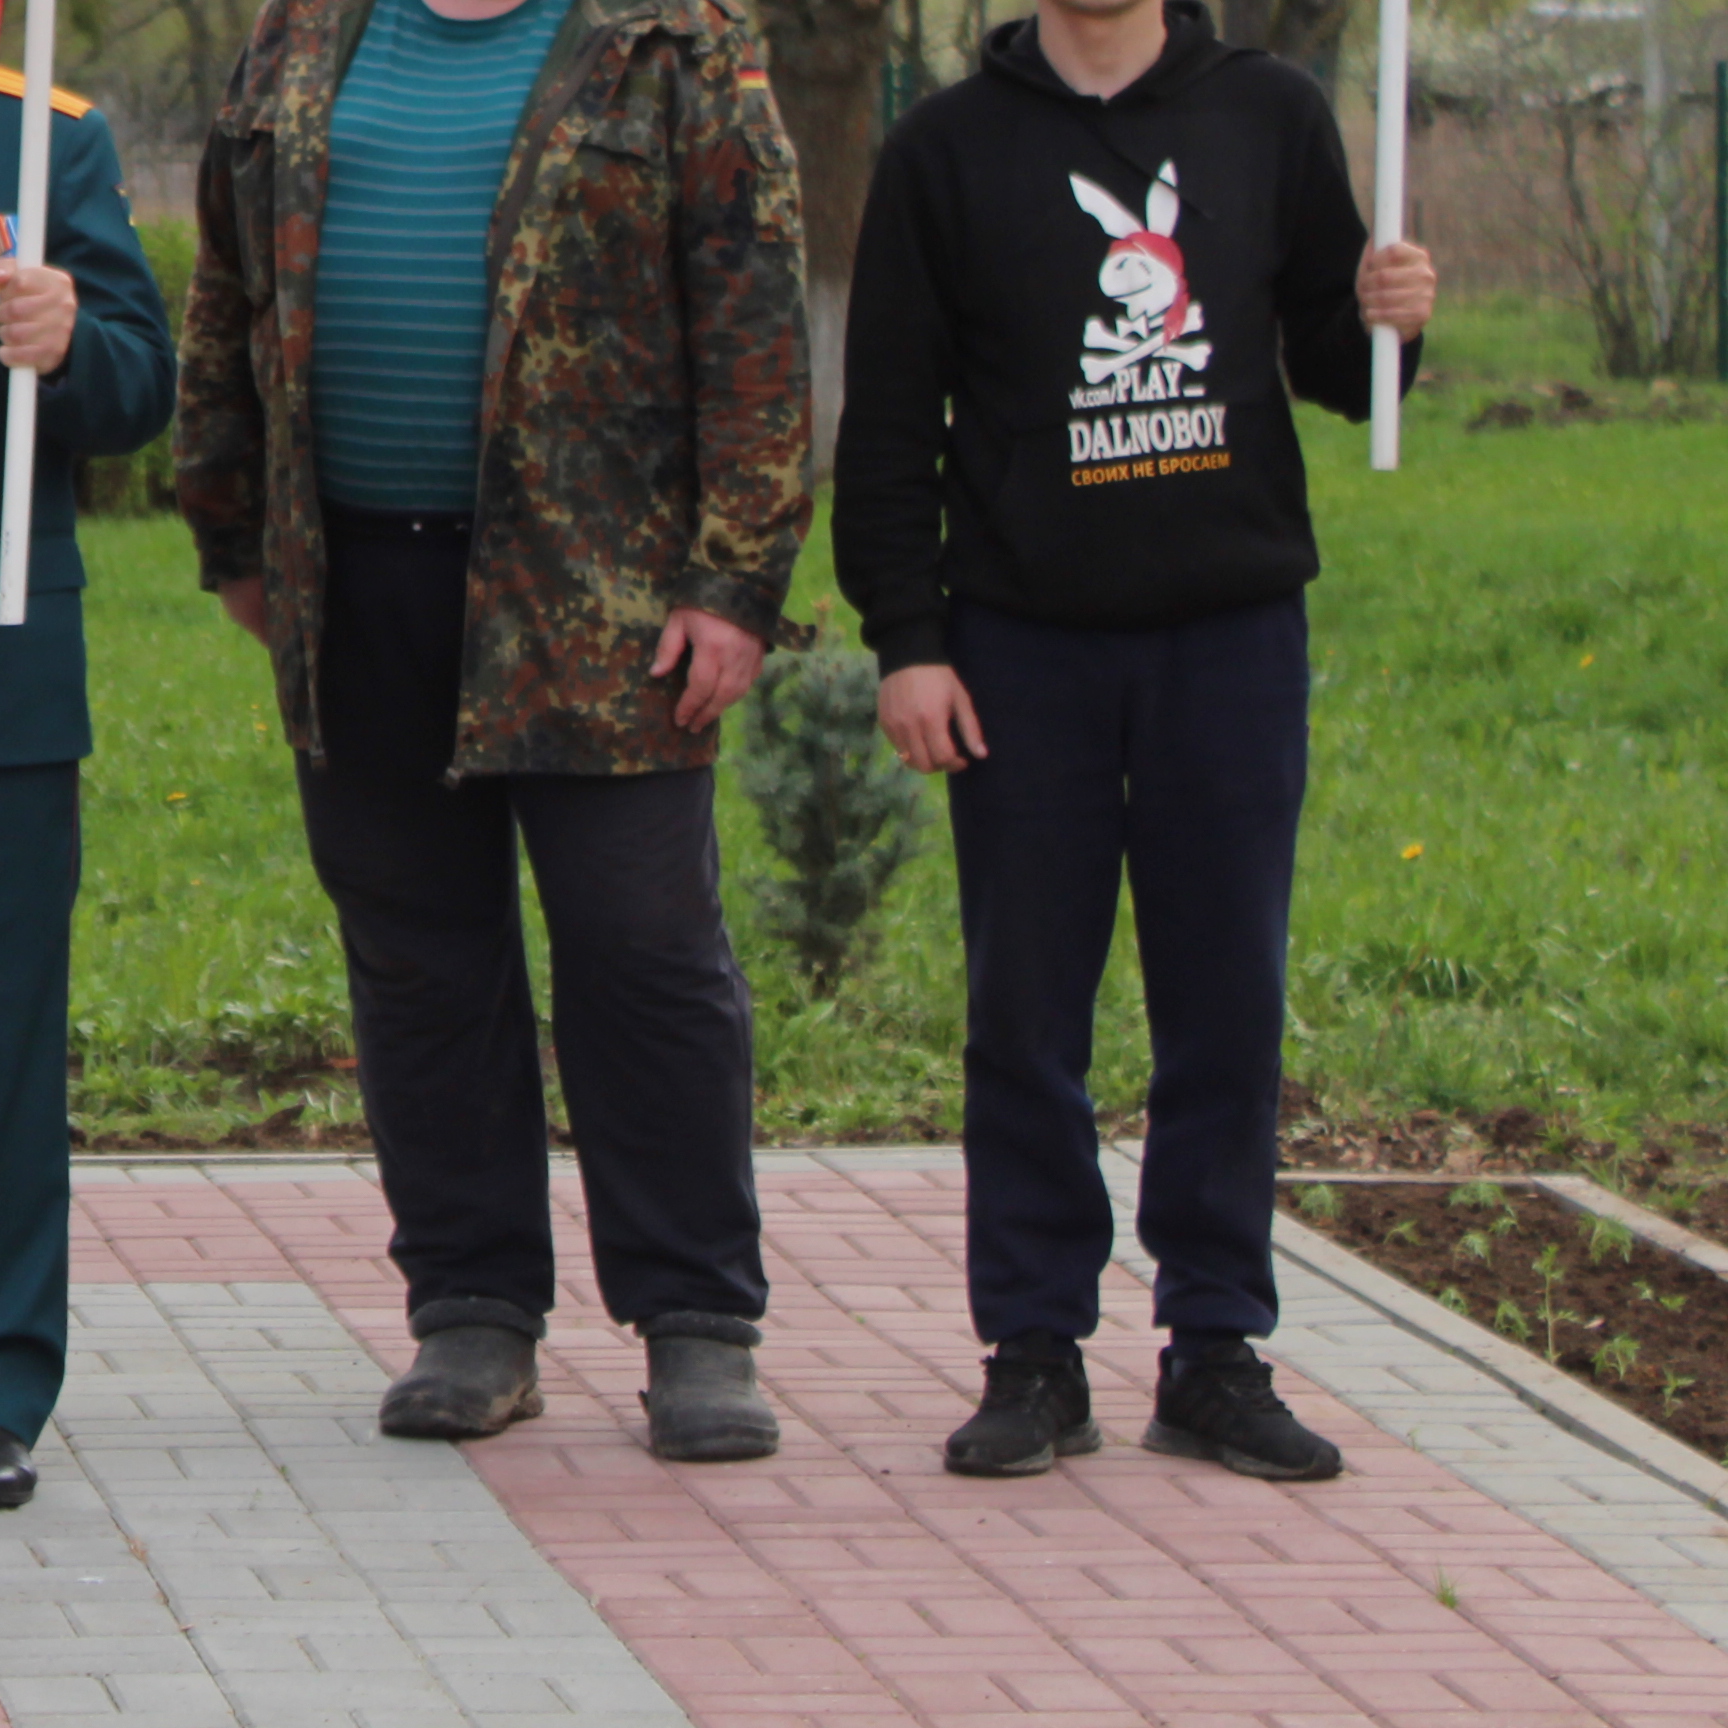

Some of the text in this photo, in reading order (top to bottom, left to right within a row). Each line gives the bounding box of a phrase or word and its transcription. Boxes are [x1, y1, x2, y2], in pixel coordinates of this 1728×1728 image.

[1068, 404, 1227, 463] DALNOBOY
[1071, 452, 1231, 487] СВОИХ НЕ БРОСАЕМ
